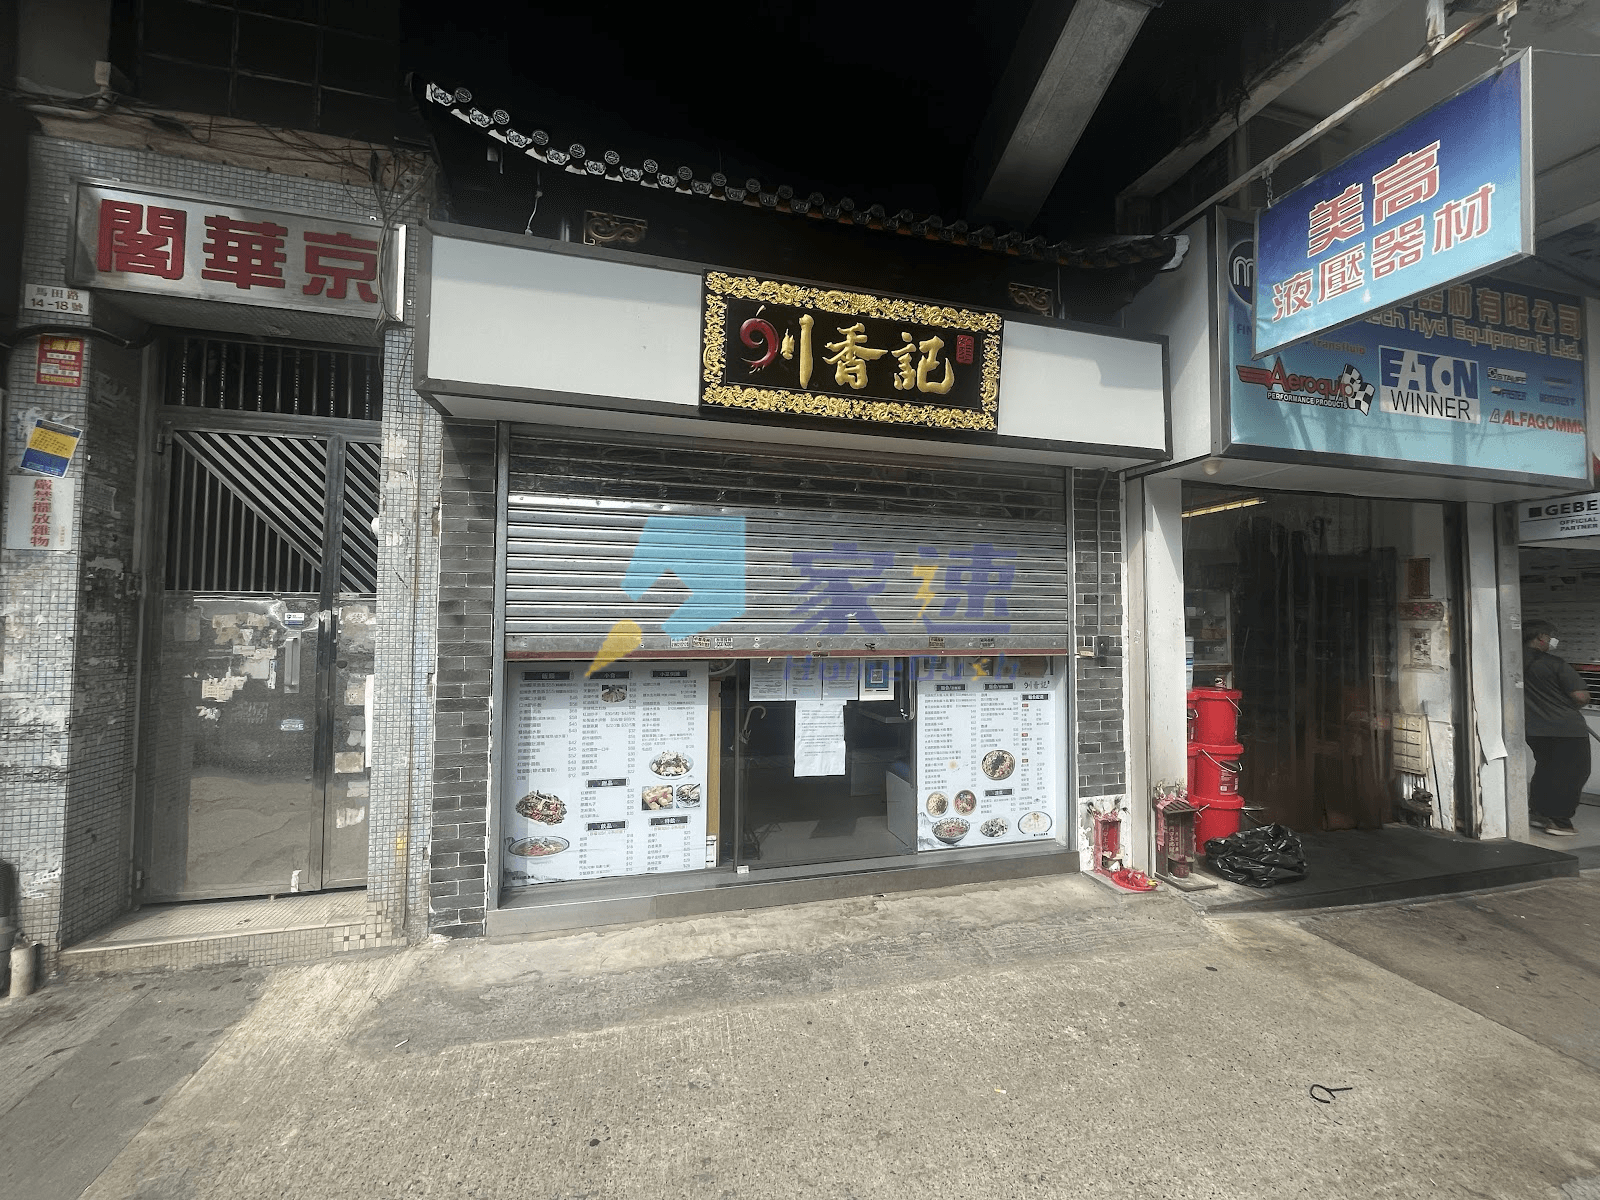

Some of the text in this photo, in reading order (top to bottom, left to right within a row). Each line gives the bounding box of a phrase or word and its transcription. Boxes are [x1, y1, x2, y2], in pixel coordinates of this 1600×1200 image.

[1307, 139, 1441, 258] 美高
[1271, 182, 1496, 323] 液壓器材
[1402, 284, 1581, 340] 器材有限公司
[1409, 310, 1448, 338] Hyd
[1452, 318, 1547, 354] Equipment
[1267, 356, 1354, 401] Aeroquip
[1381, 348, 1479, 399] EATON
[1267, 391, 1348, 408] PERFORMANCE PRODUCTS
[1390, 389, 1471, 421] WINNER
[1545, 499, 1598, 516] GEBE
[1560, 517, 1598, 525] OFFICIAL
